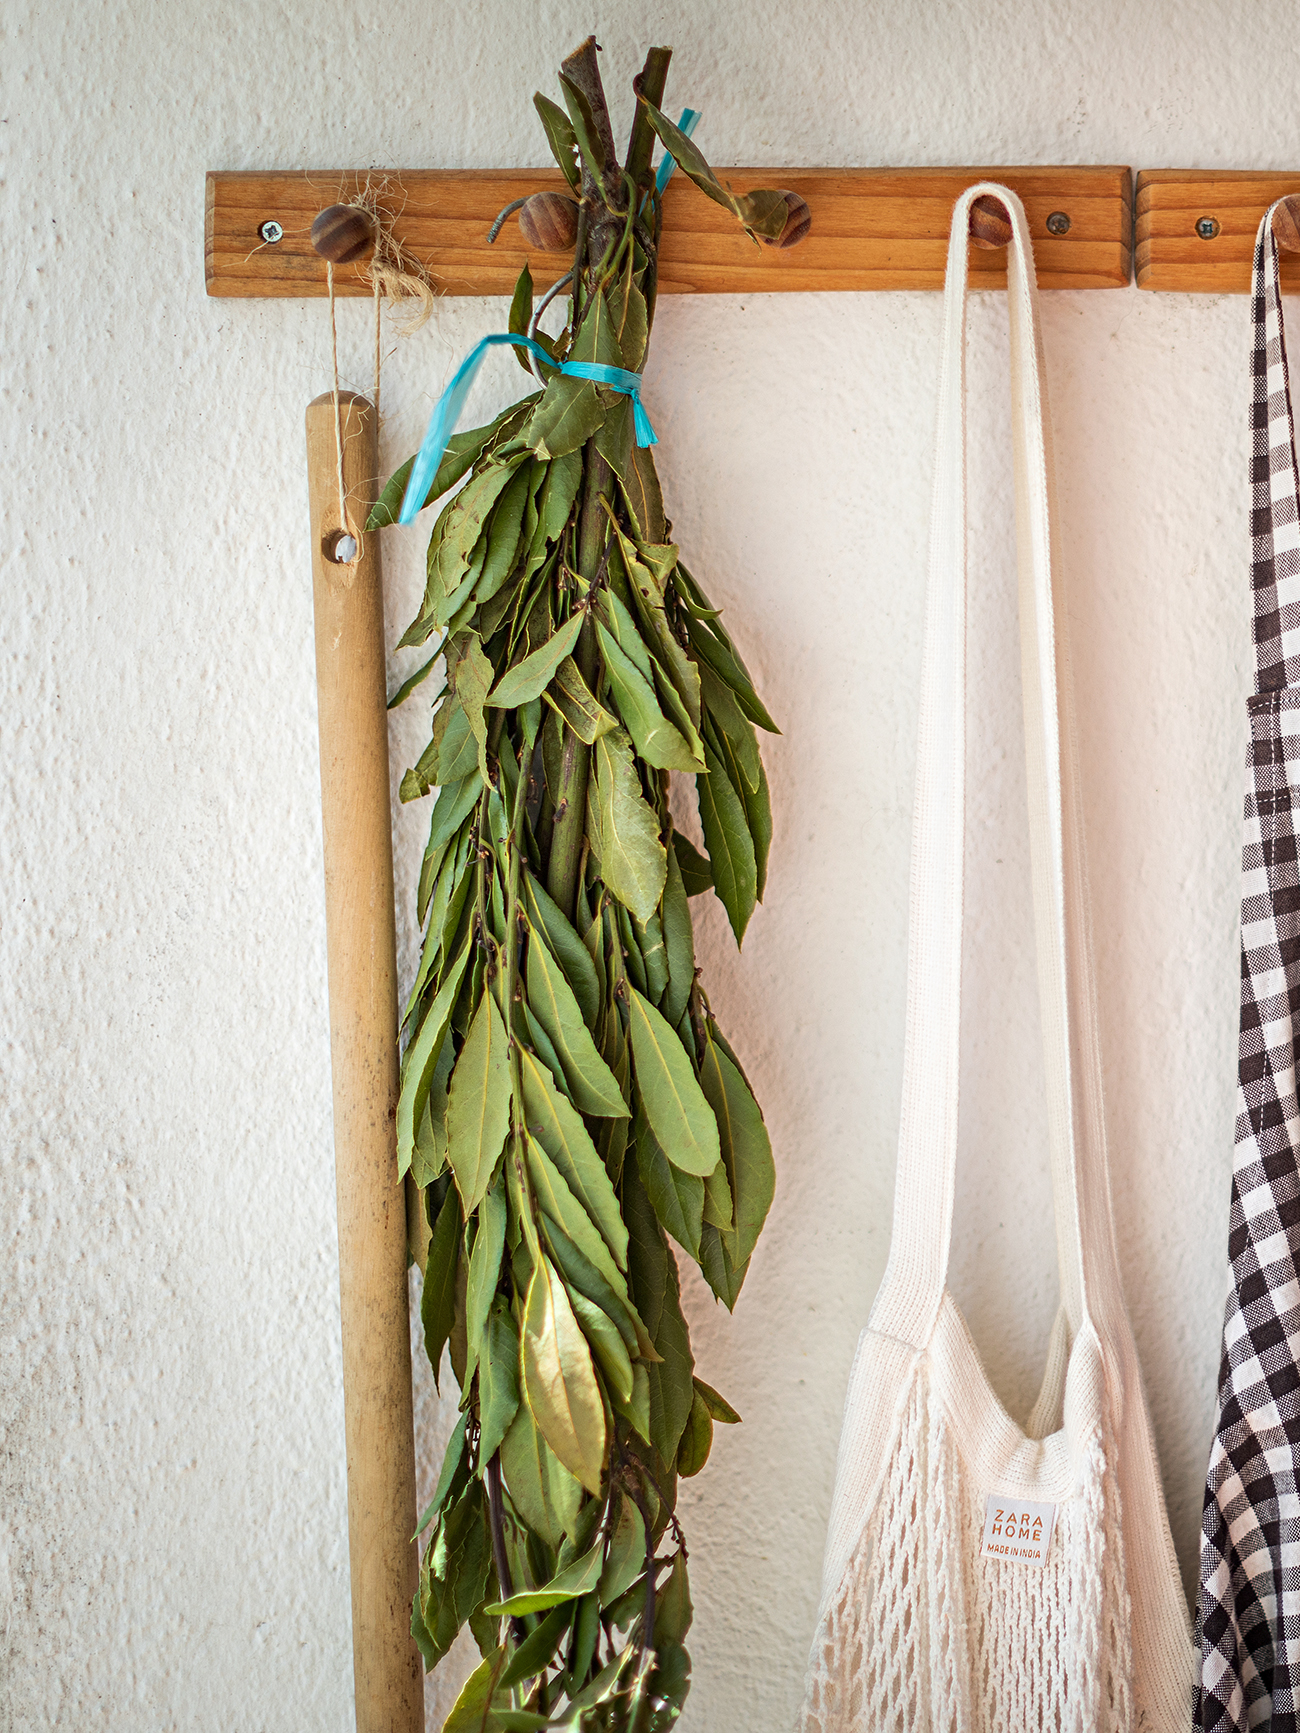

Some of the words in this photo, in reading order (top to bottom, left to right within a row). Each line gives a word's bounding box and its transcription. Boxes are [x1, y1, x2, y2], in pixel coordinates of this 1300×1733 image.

[994, 1509, 1043, 1528] ZARA
[992, 1523, 1042, 1541] HOME
[987, 1543, 1010, 1555] MADE
[1010, 1547, 1019, 1556] IN
[1019, 1548, 1041, 1559] INDIA
